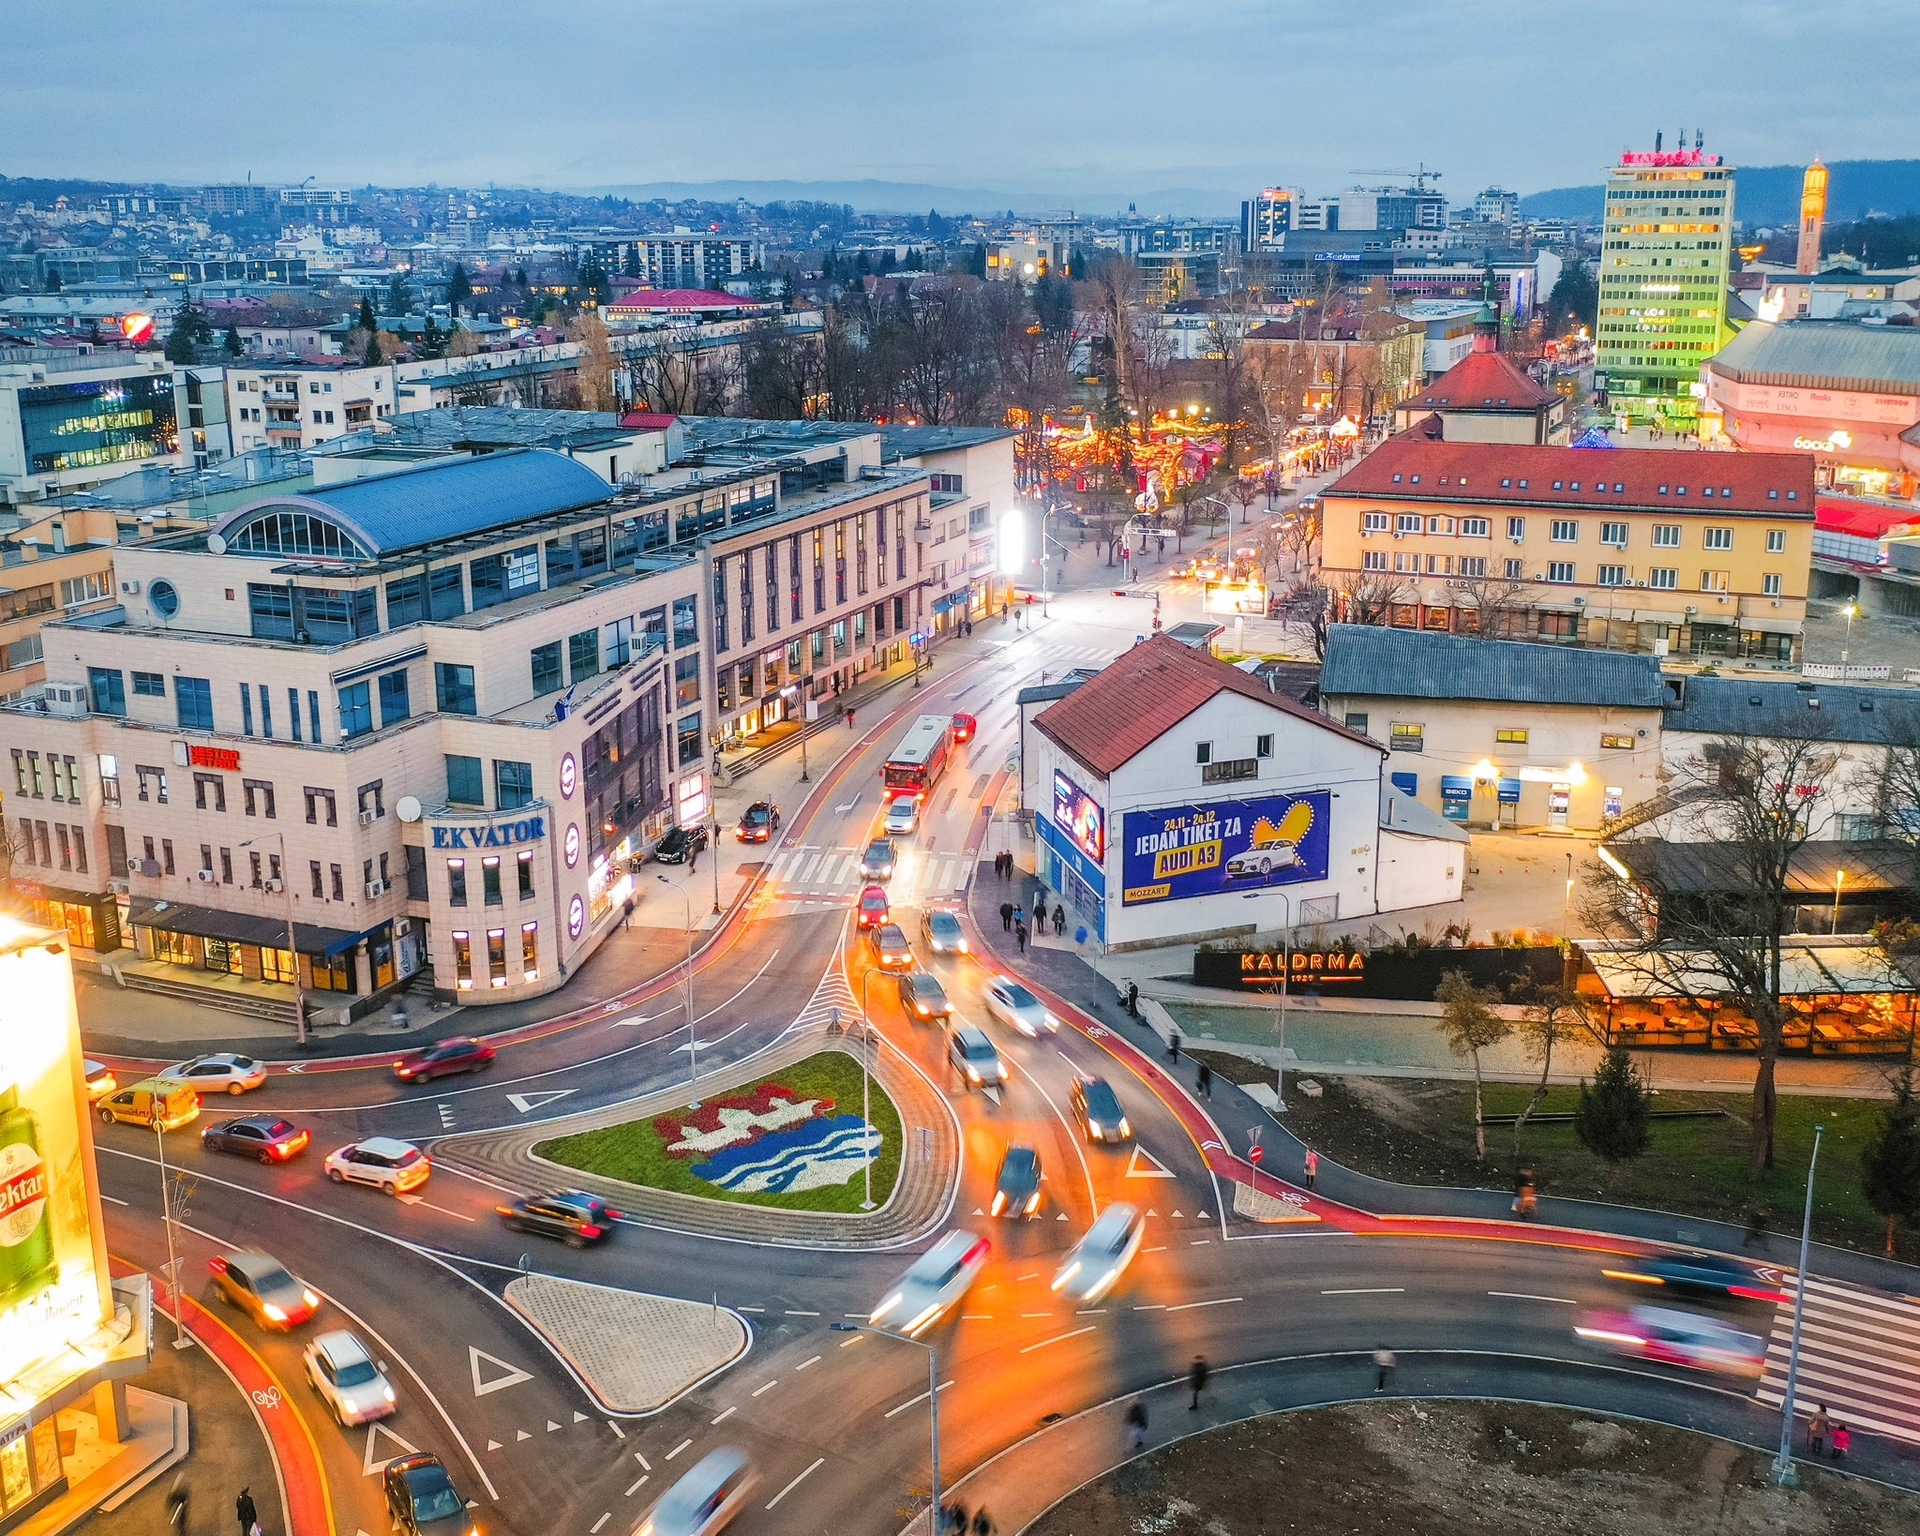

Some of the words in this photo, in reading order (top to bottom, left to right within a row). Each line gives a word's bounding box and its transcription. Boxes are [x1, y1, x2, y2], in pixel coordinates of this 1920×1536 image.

[1445, 788, 1468, 796] BEKO
[1164, 818, 1186, 831] 24.11
[1193, 810, 1216, 825] 24.12
[431, 816, 546, 849] EKVATOR
[1135, 830, 1178, 857] JEDAN
[1182, 821, 1221, 848] TIKET
[1224, 817, 1242, 838] ZA
[1159, 850, 1194, 874] AUDI
[1197, 846, 1216, 867] A3
[1129, 886, 1166, 899] MOZZART
[1241, 953, 1364, 971] KALDRMA
